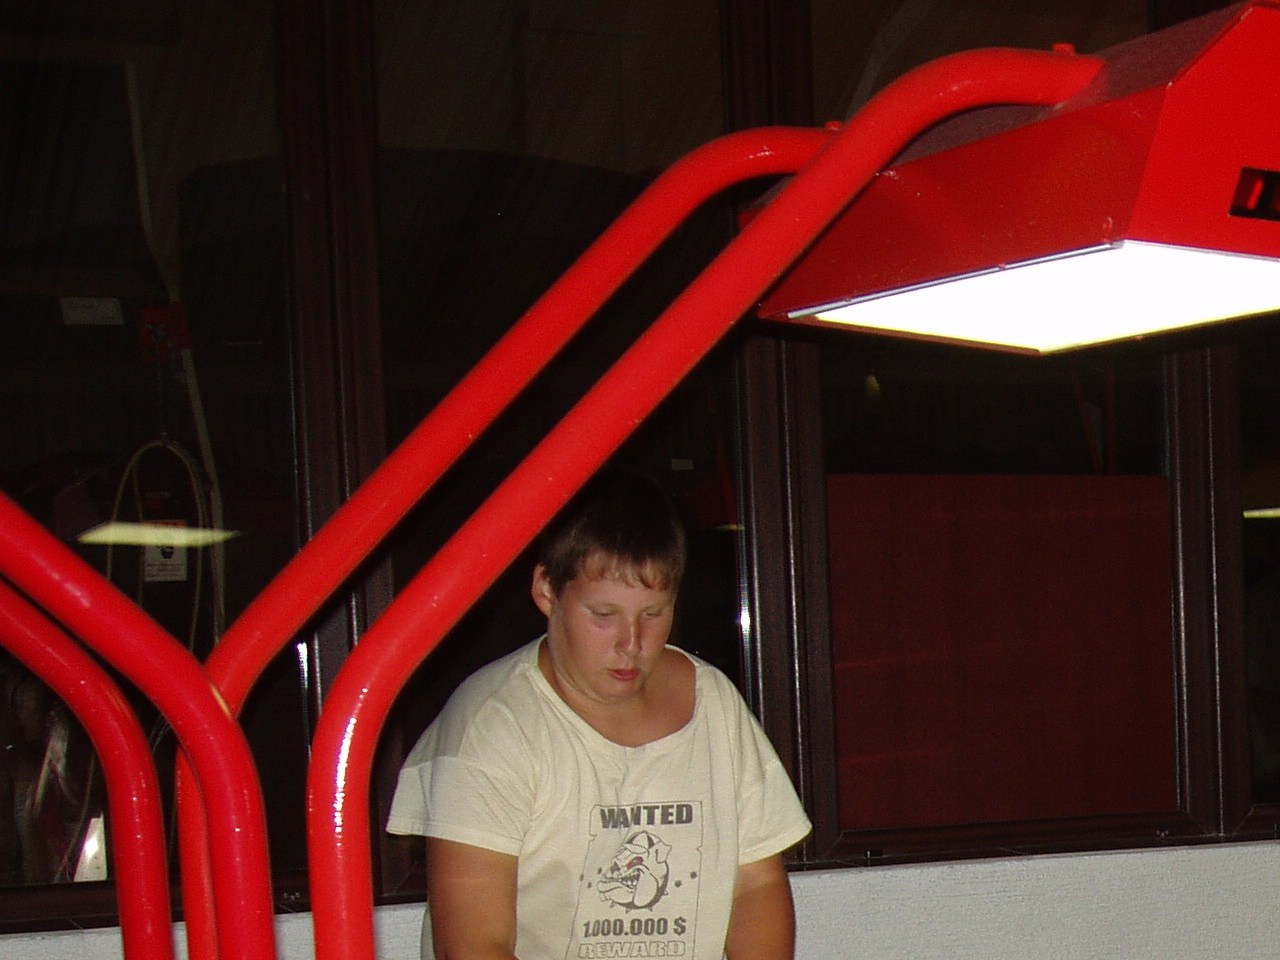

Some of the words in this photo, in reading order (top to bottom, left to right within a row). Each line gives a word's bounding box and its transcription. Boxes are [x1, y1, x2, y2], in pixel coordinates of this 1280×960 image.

[1247, 178, 1264, 210] 1
[600, 804, 693, 829] WANTED
[583, 917, 669, 938] 1.000.000
[673, 916, 687, 936] $
[578, 941, 687, 960] REWARD
